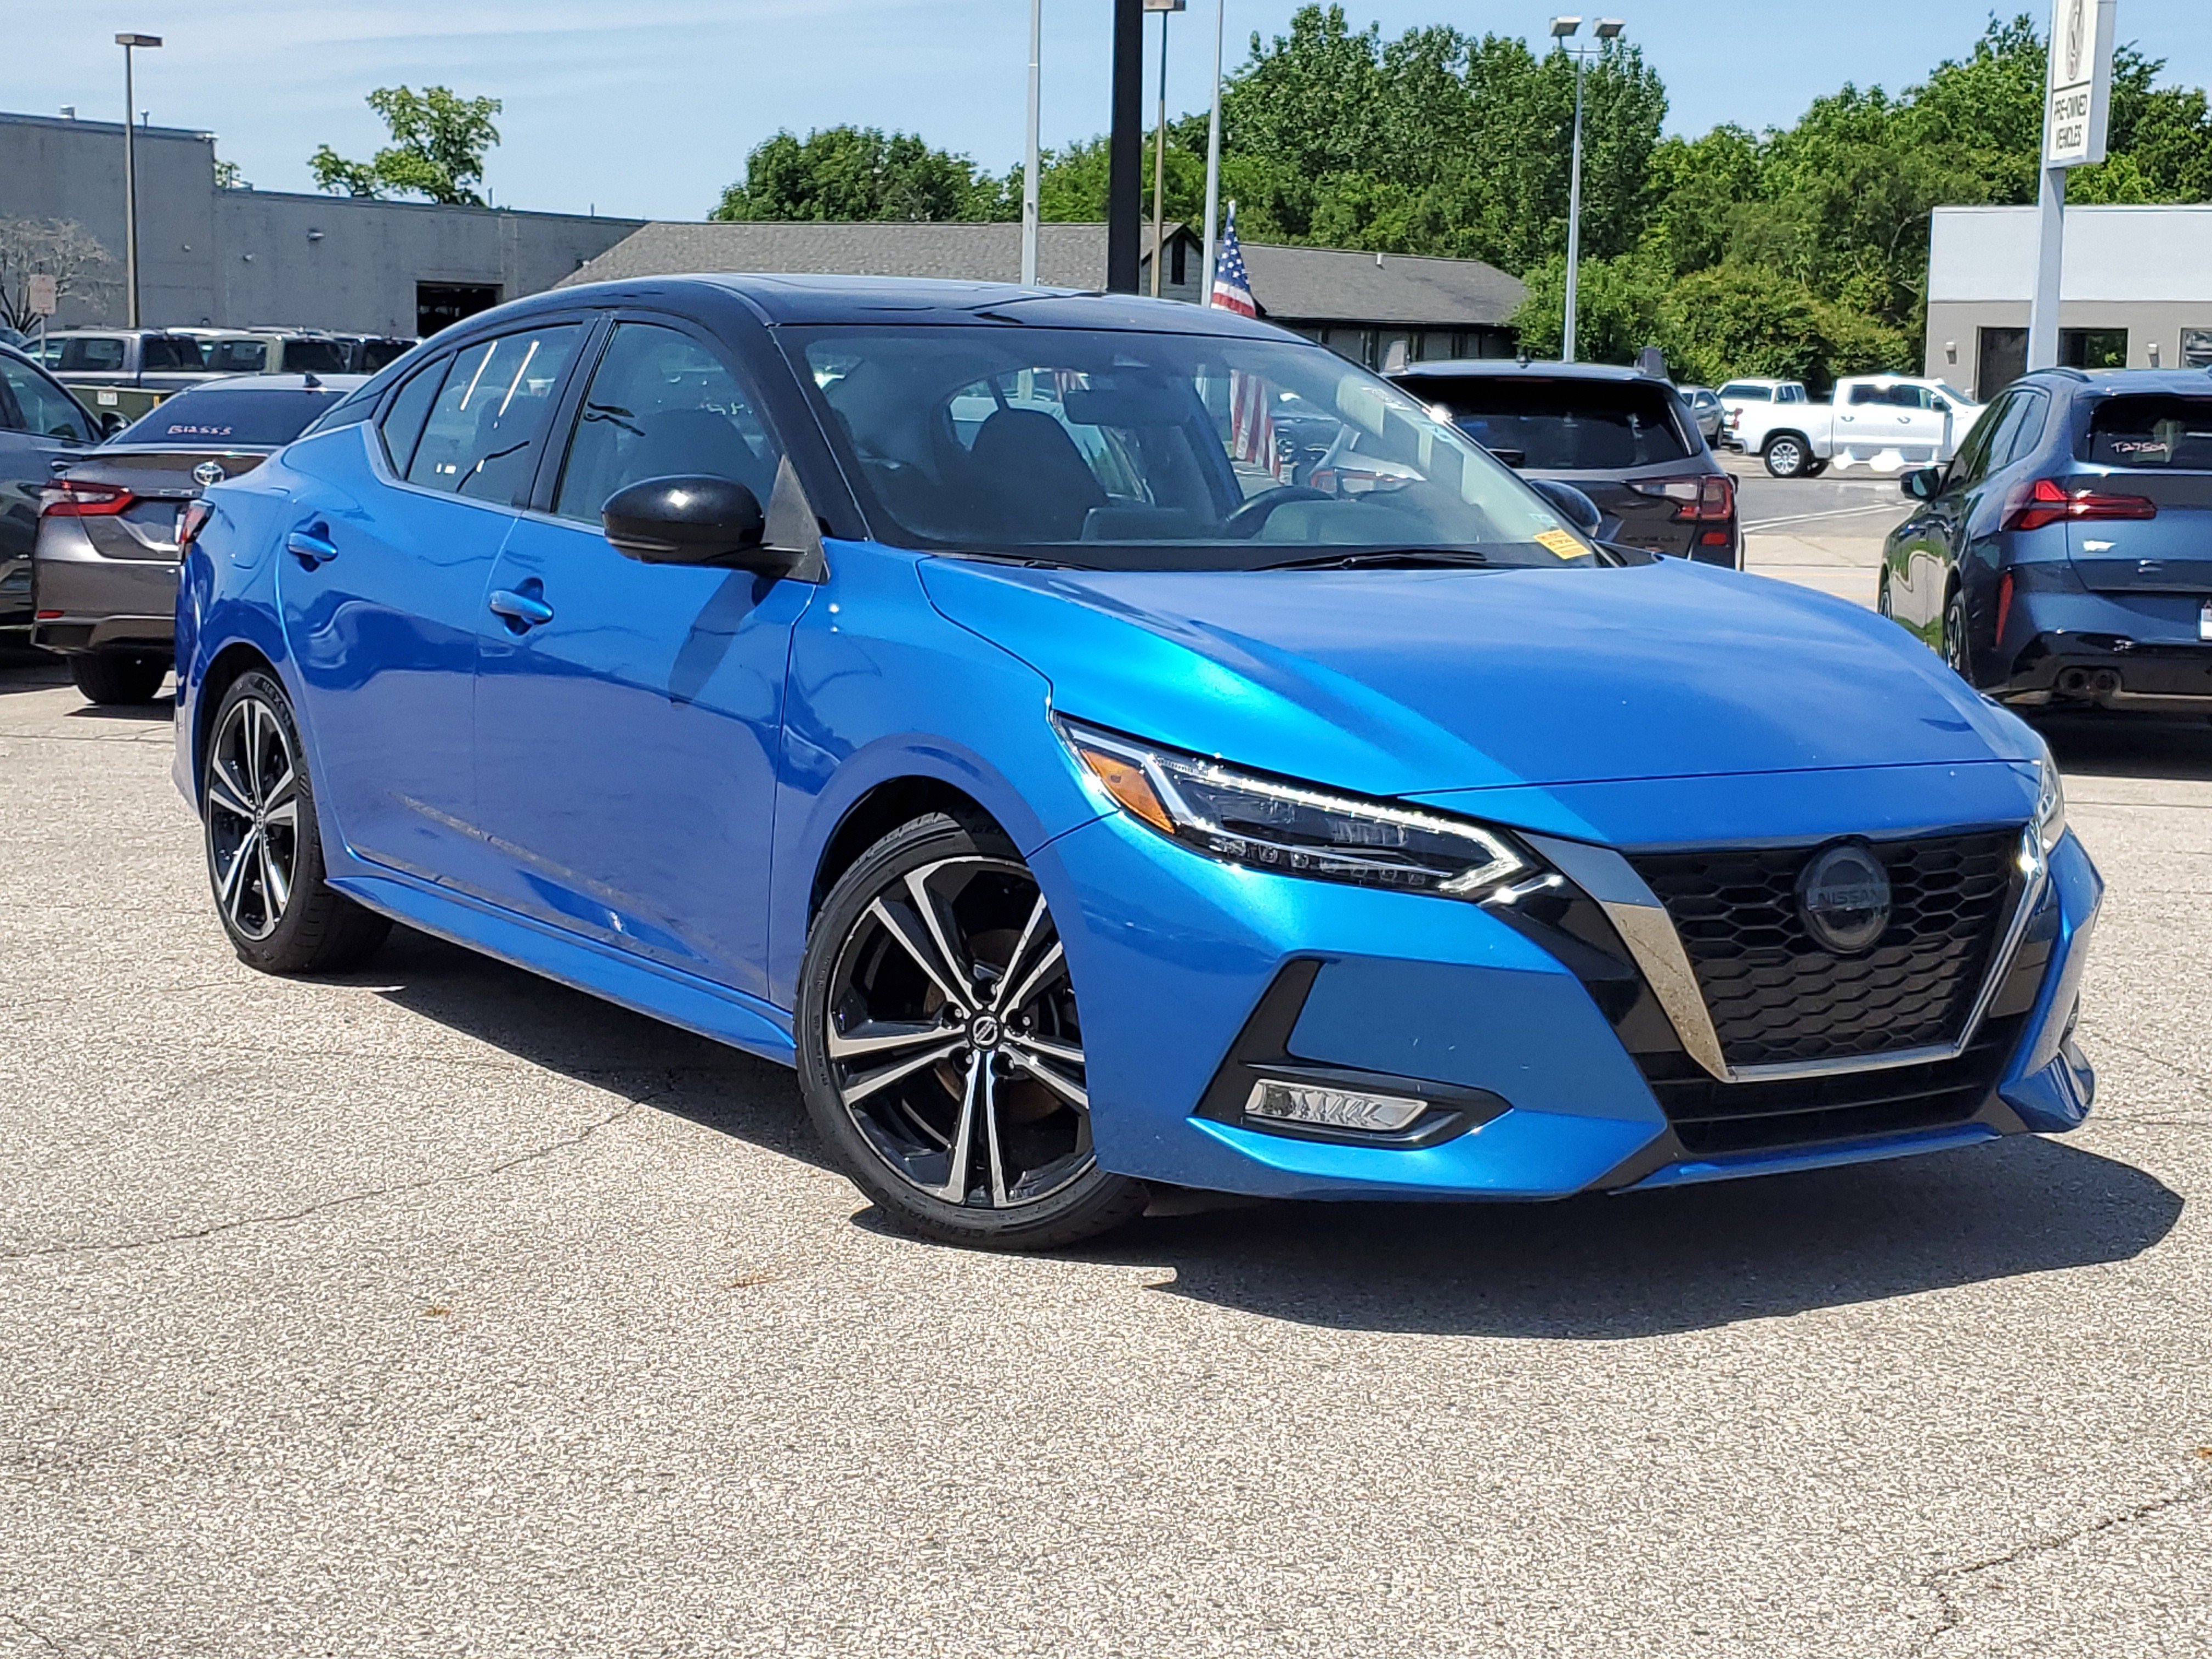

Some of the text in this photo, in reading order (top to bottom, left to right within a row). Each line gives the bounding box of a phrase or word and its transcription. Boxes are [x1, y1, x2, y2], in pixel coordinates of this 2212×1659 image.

[2053, 93, 2087, 122] PRE-OWNED
[2056, 124, 2082, 150] VEHICLES
[1817, 888, 1878, 905] NISSAN
